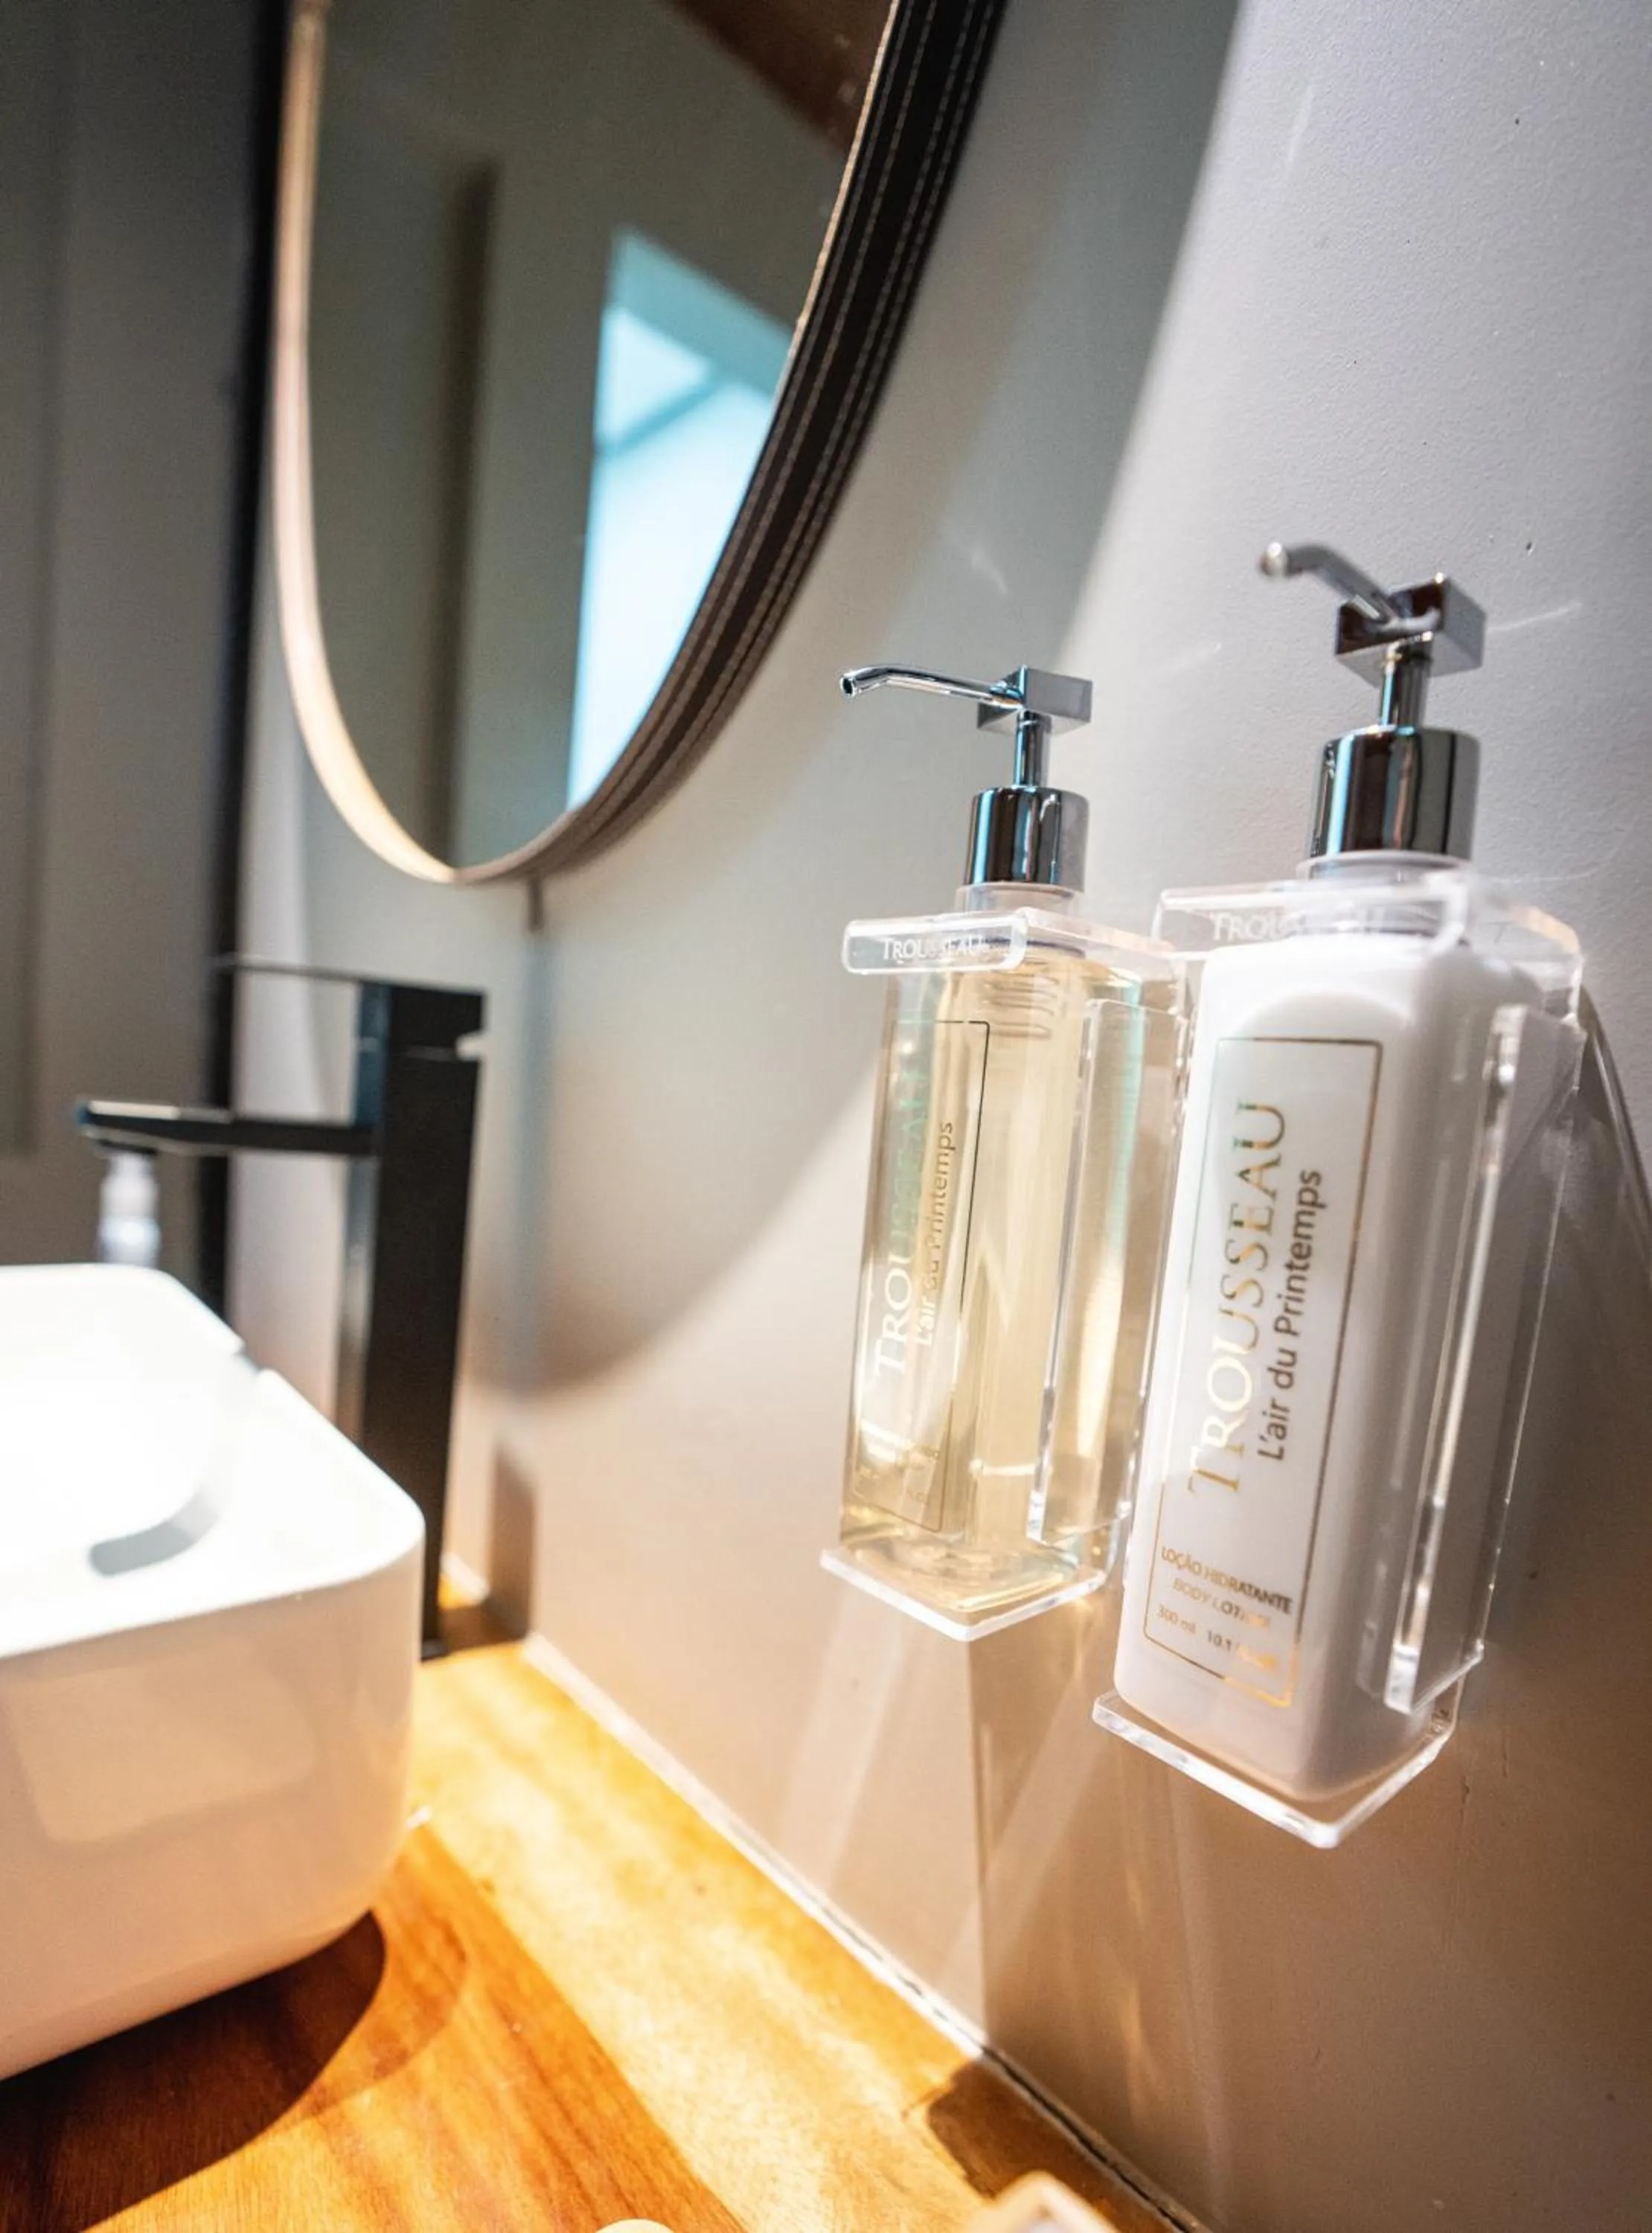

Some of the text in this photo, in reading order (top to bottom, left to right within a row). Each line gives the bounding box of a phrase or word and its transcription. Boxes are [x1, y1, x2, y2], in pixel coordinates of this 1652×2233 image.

[926, 1121, 956, 1249] Printemps
[1188, 1102, 1286, 1492] TROUSSEAU
[1258, 1169, 1326, 1462] L'air du Printemps
[1172, 1576, 1211, 1603] BODY
[1204, 1567, 1294, 1615] HIDRATANTE
